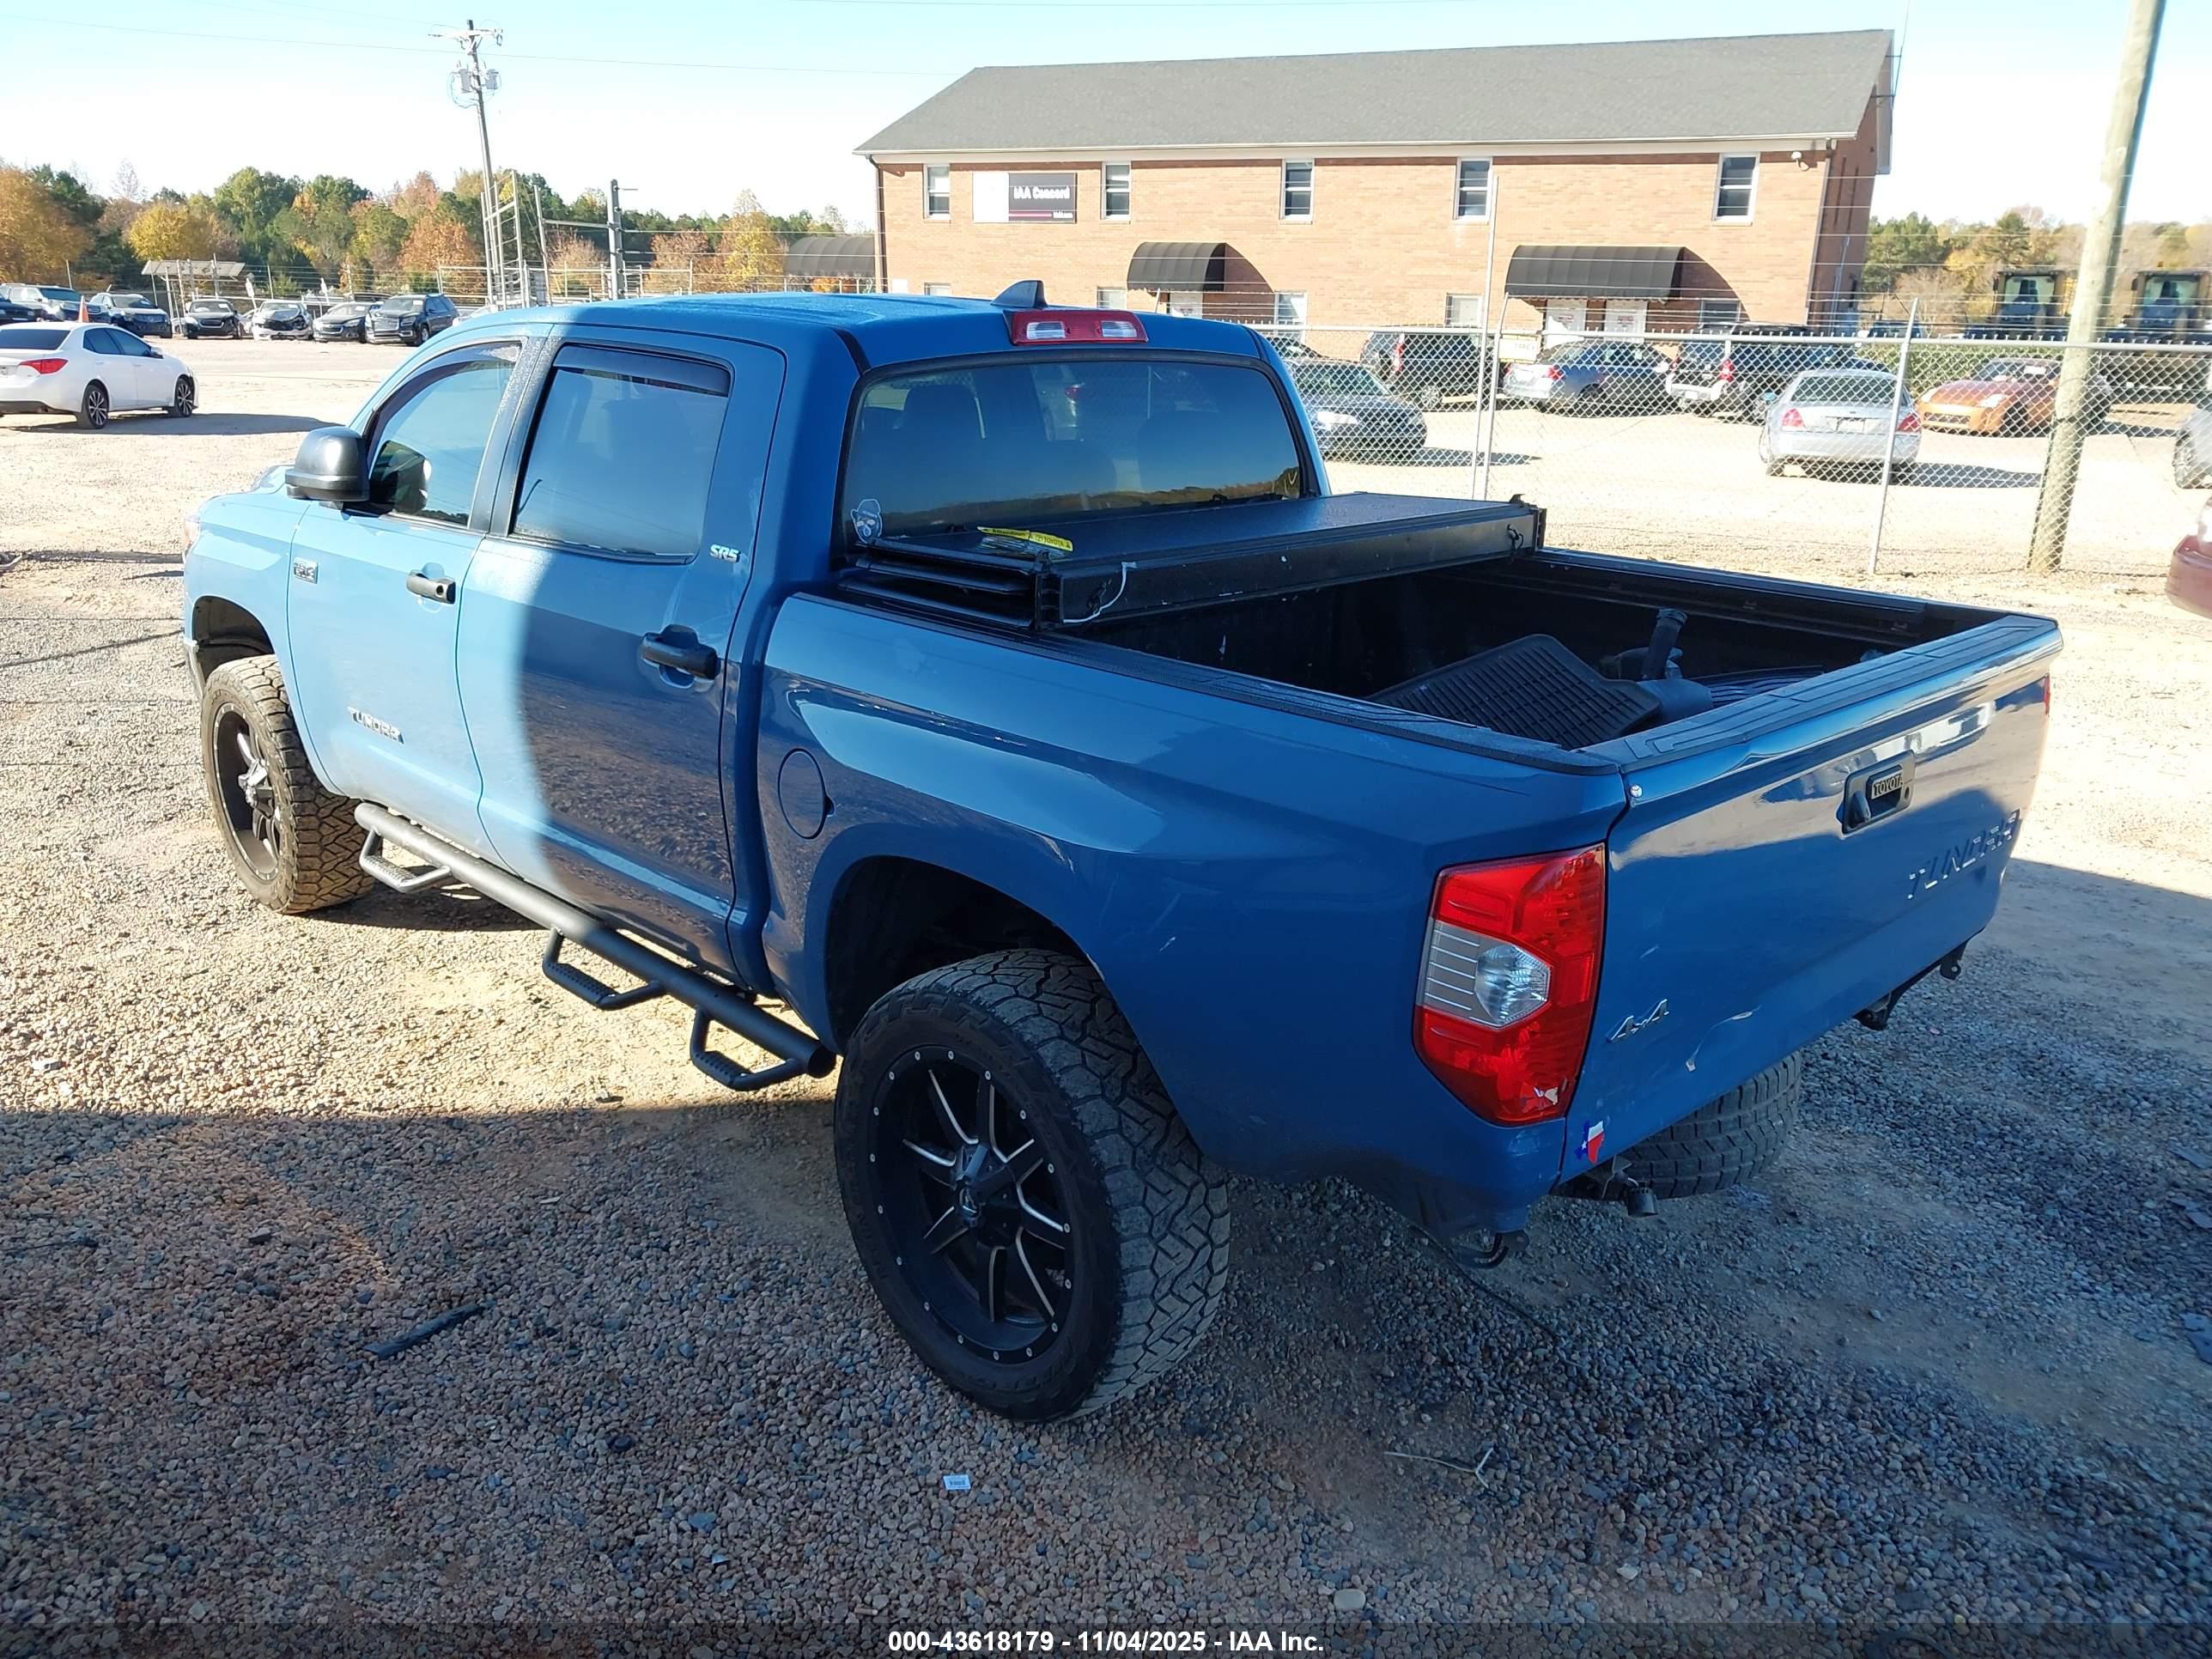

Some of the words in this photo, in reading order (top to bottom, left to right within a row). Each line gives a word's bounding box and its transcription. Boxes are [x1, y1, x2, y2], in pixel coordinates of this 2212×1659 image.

[1013, 185, 1031, 199] IAA
[347, 706, 404, 745] TUNDRA
[1907, 808, 2021, 900] TUNDRA
